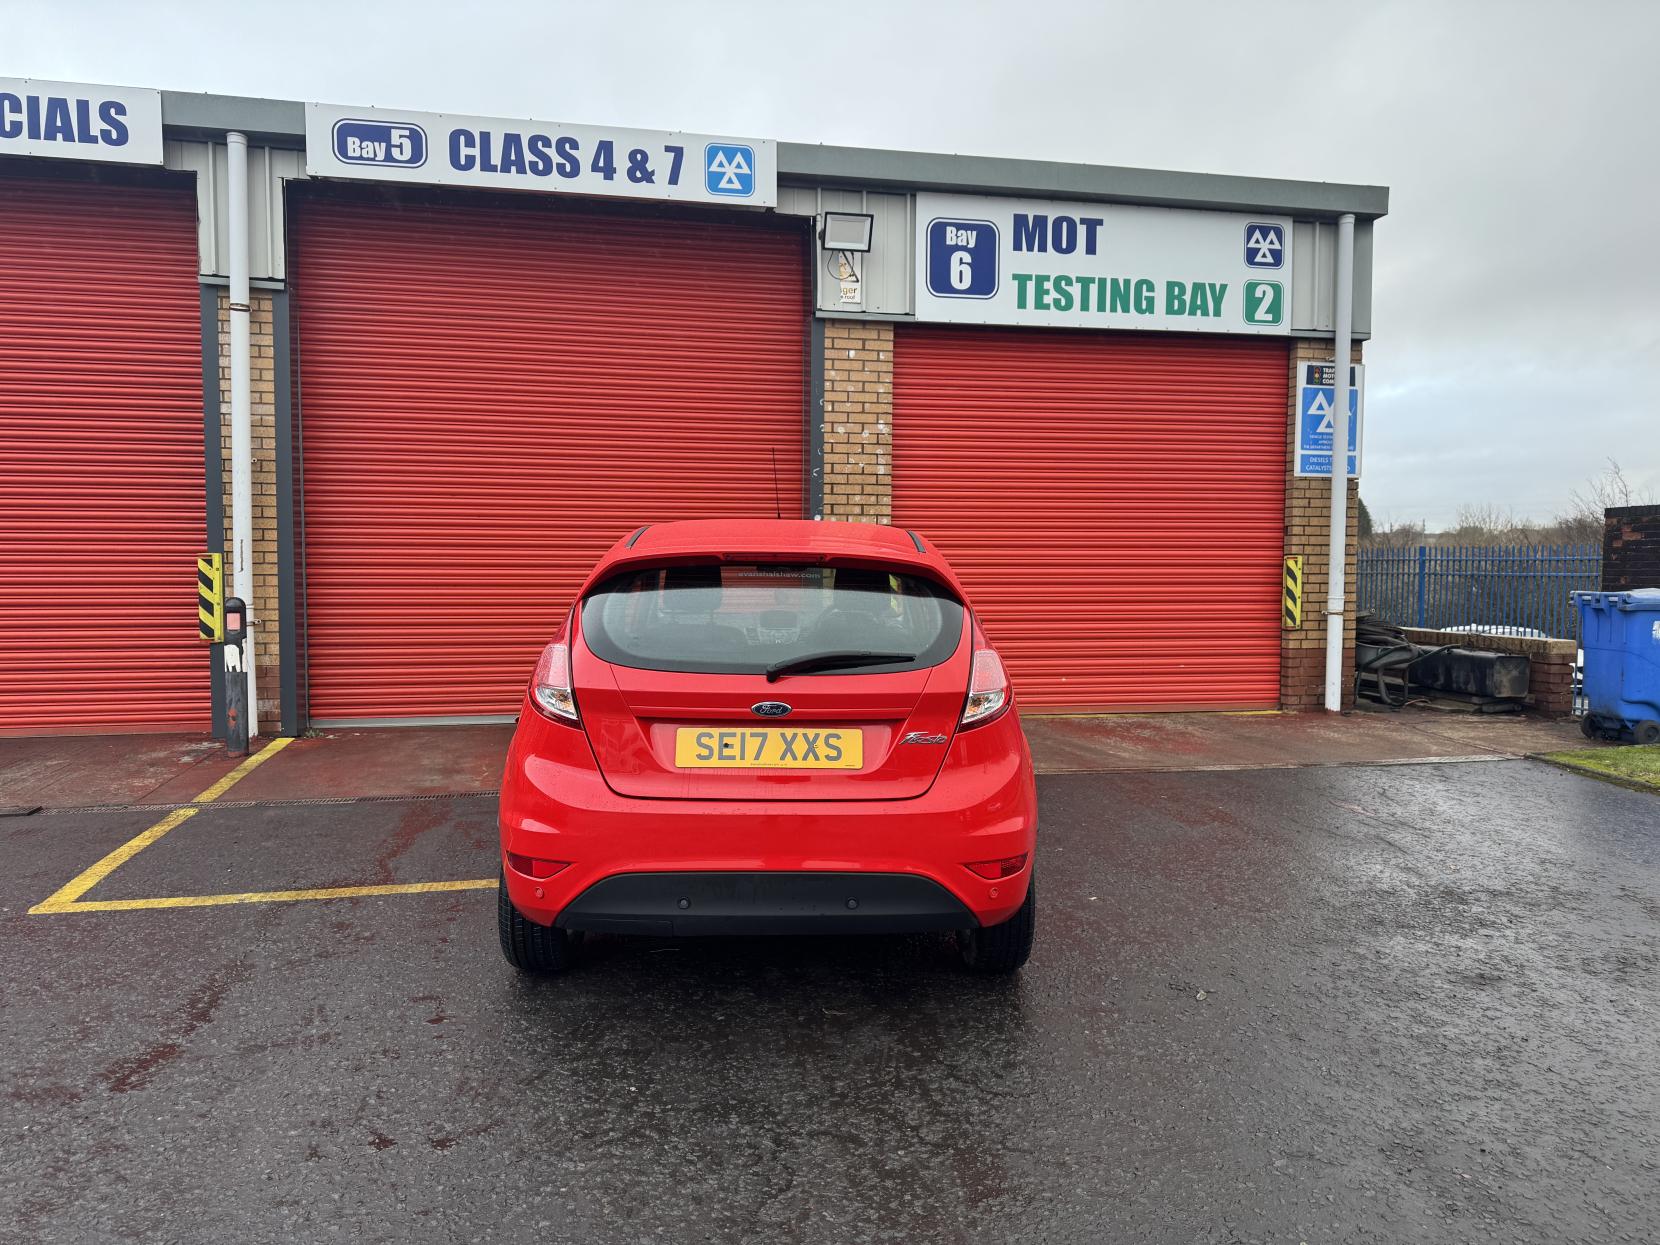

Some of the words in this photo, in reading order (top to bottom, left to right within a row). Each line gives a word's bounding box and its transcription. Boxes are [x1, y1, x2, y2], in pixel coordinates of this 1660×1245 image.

[346, 136, 387, 161] Bay
[390, 128, 412, 161] 5
[448, 128, 581, 179] CLASS
[590, 139, 617, 182] 4
[626, 148, 656, 185] &
[663, 144, 685, 186] 7
[945, 226, 977, 249] Bay
[1012, 212, 1105, 256] MOT
[949, 250, 973, 291] 6
[1011, 273, 1157, 316] TESTING
[1164, 280, 1230, 320] BAY
[1254, 283, 1275, 321] 2
[695, 732, 768, 761] SE17
[780, 733, 843, 762] XXS
